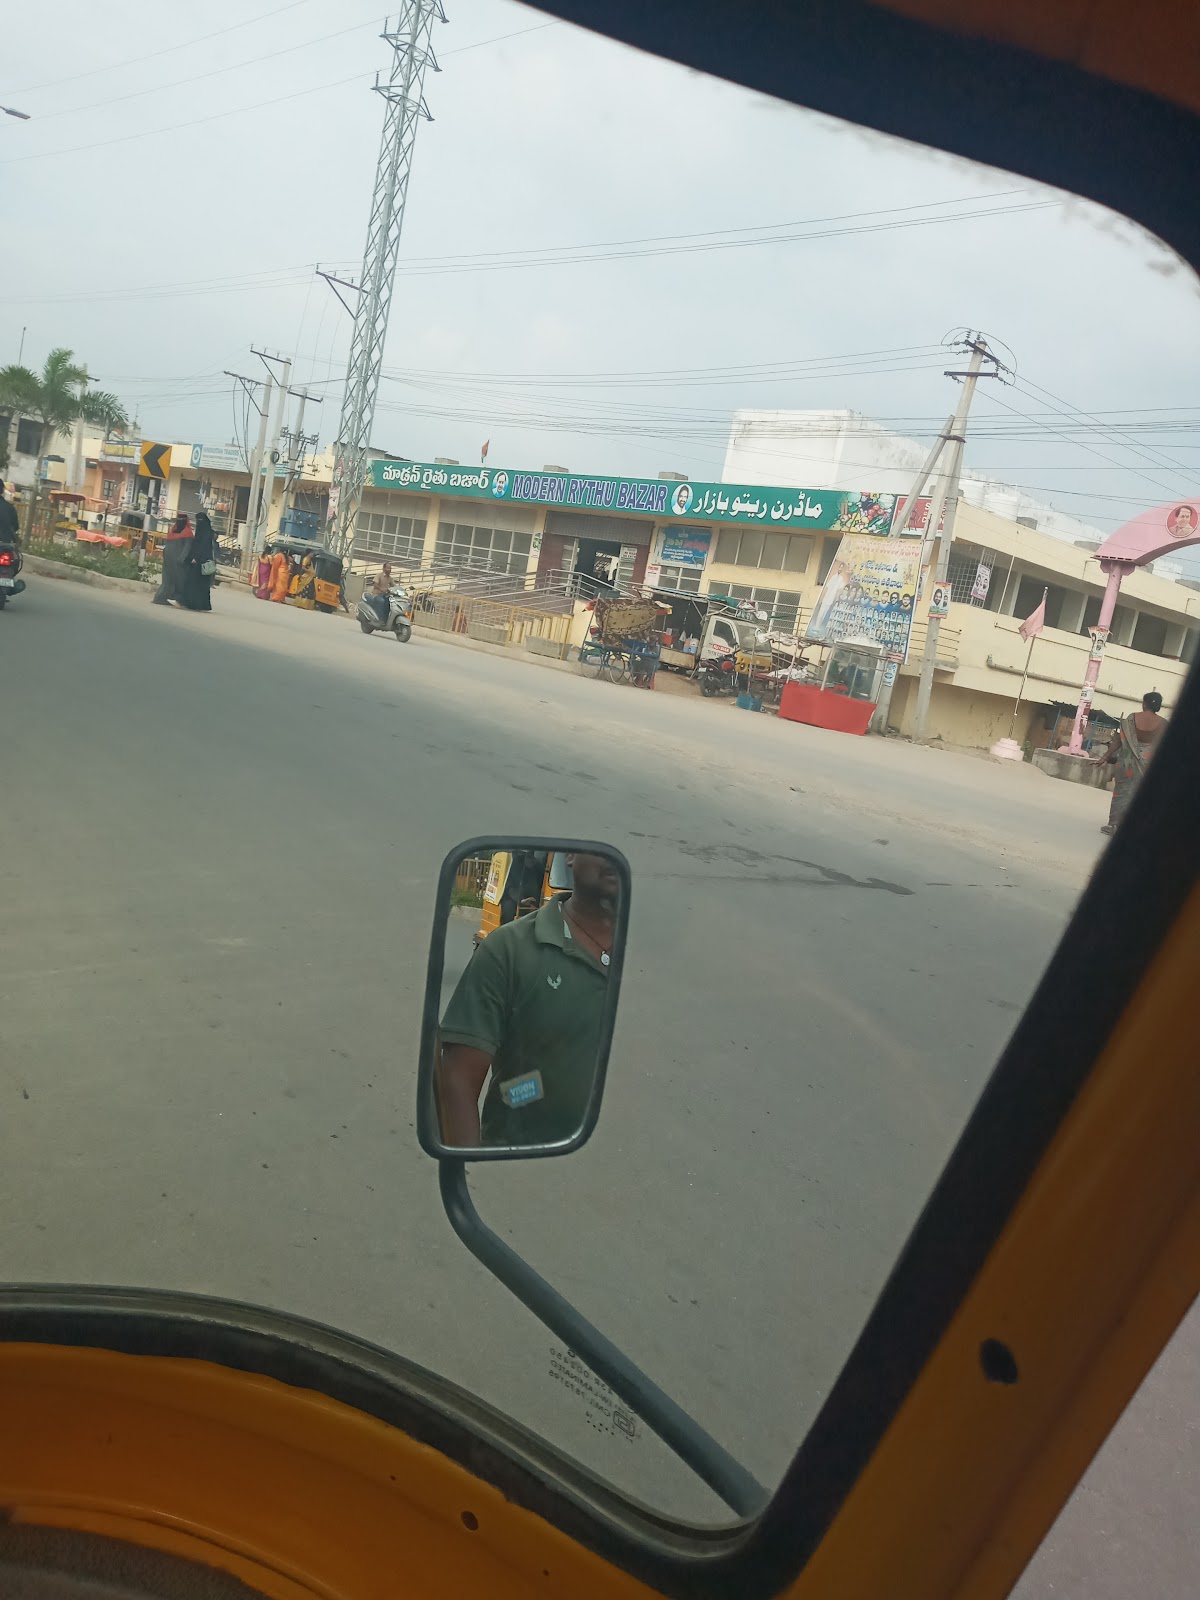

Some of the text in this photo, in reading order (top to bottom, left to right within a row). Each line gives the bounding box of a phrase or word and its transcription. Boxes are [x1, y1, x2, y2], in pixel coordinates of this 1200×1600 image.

[420, 468, 448, 489] రైతు
[449, 469, 491, 490] బజార్
[511, 474, 668, 512] MODERN RYTHU BAZAR
[692, 489, 823, 521] ماڈرن ریتو بازار
